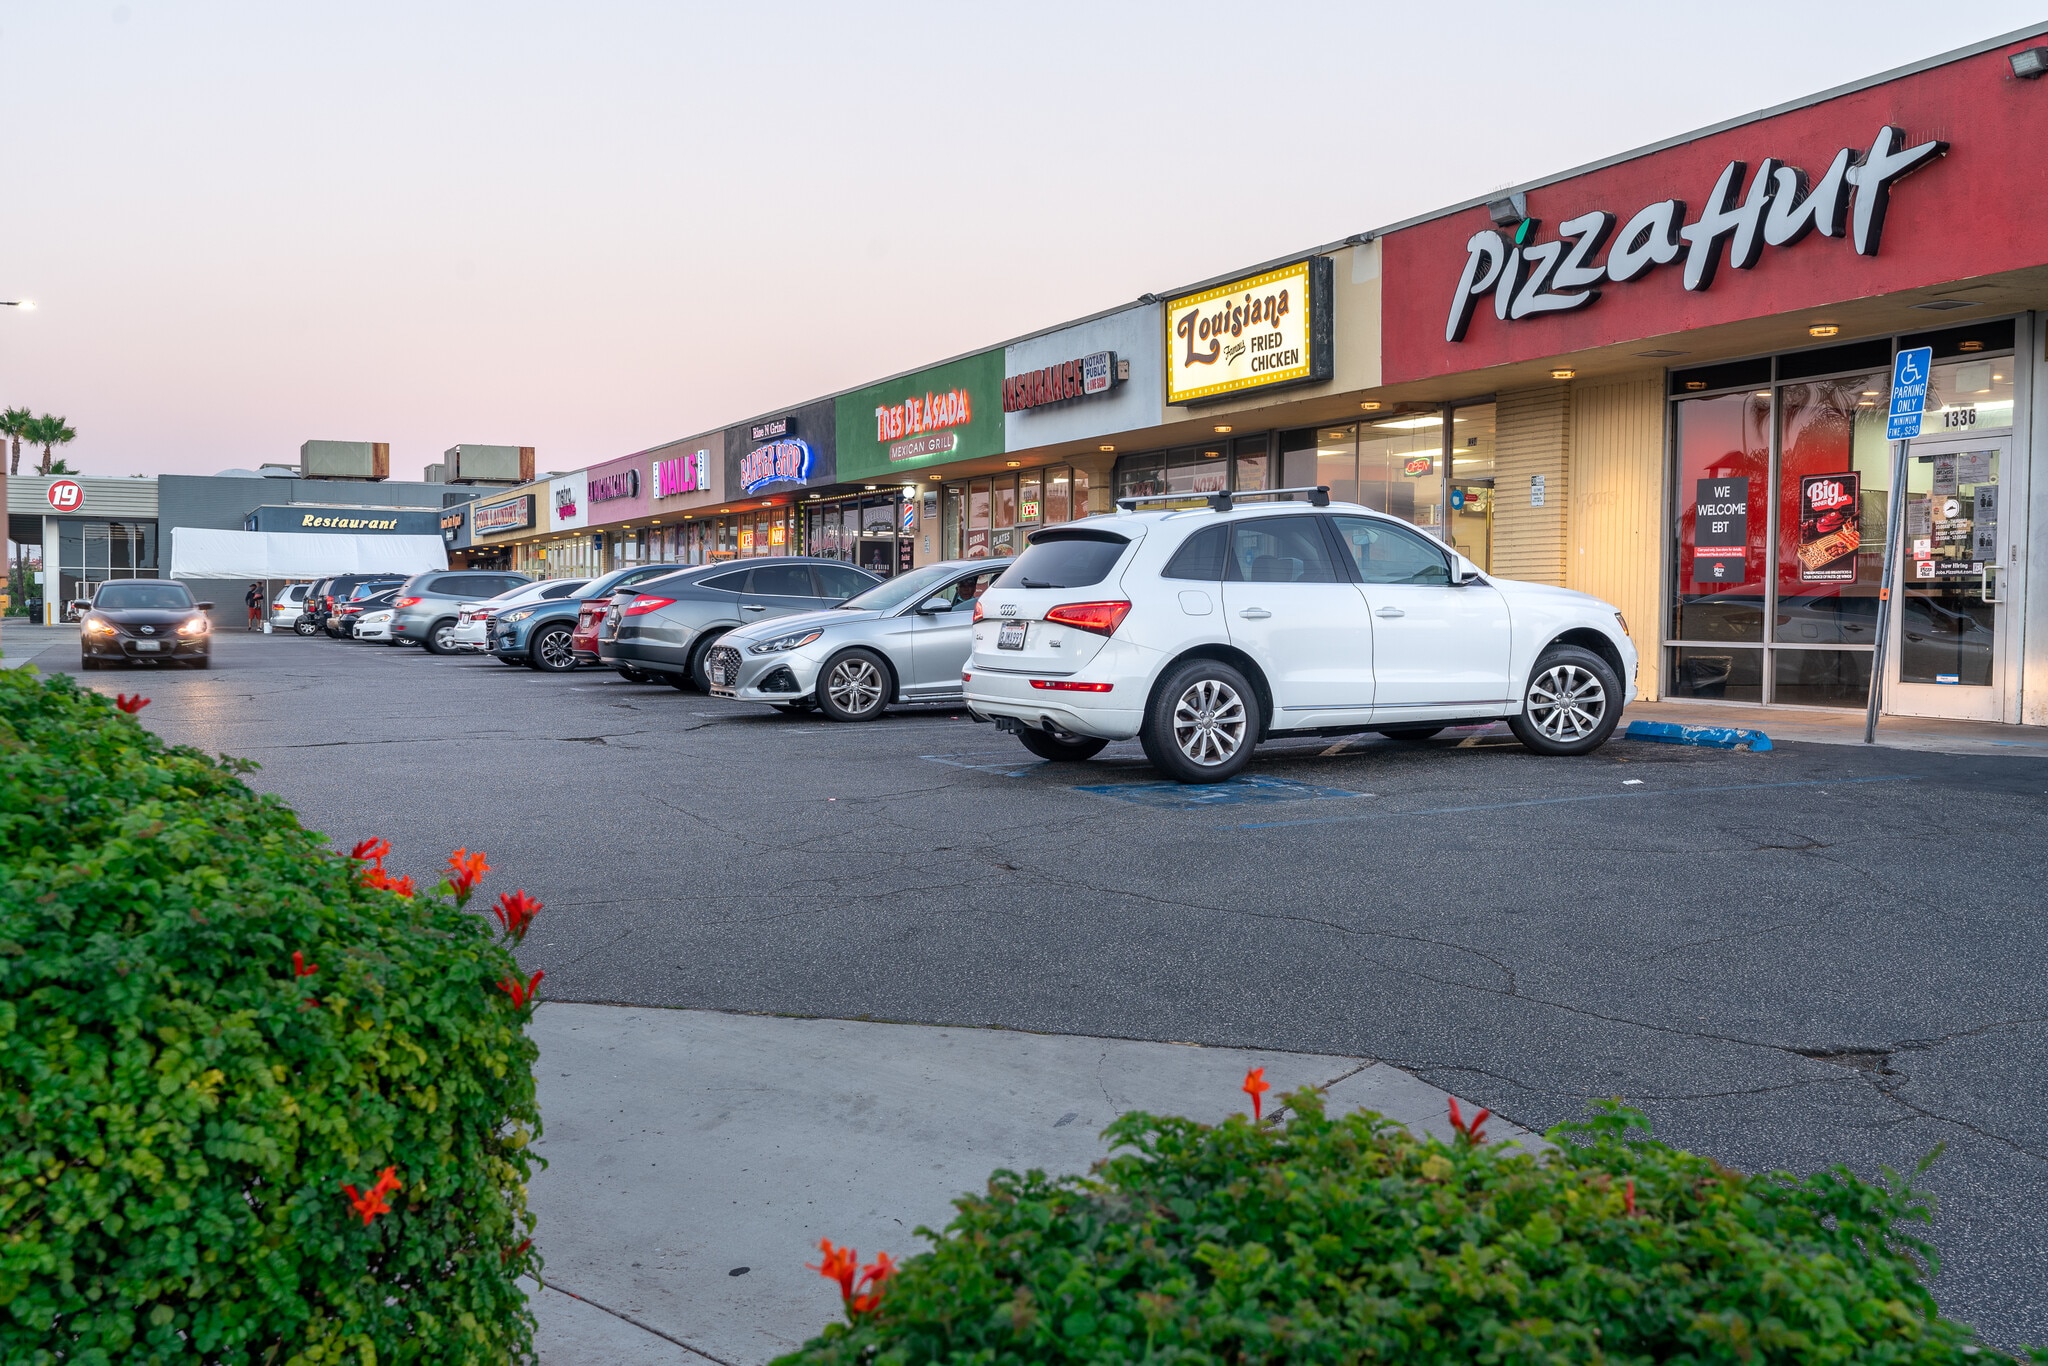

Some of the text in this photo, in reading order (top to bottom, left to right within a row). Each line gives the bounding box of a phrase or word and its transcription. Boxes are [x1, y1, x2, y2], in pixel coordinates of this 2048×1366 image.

[1681, 125, 1950, 291] Hut
[1177, 289, 1289, 368] Louisiana
[1251, 332, 1283, 353] FRIED
[1085, 353, 1107, 368] NOTARY
[1251, 348, 1299, 372] CHICKEN
[1086, 365, 1107, 379] PUBLIC
[1001, 359, 1083, 413] INSURANCE
[1893, 383, 1925, 399] PARKING
[1897, 398, 1917, 413] ONLY
[875, 389, 967, 442] TRES DE ASADA
[1893, 415, 1917, 426] MINIMUM
[1943, 408, 1976, 428] 1336
[752, 420, 786, 439] Rise N Grind
[1904, 425, 1919, 435] $250
[891, 436, 951, 458] MEXICAN GRILL
[659, 453, 697, 497] NAILS
[741, 443, 801, 490] BARBER SHOP
[1406, 460, 1429, 472] OPEN
[1193, 475, 1226, 493] NOTAR
[1714, 486, 1730, 498] WE
[1807, 480, 1839, 506] Big
[53, 485, 79, 506] 19
[476, 510, 489, 530] COIN
[490, 504, 517, 526] LAUNDRY
[1697, 503, 1746, 516] WELCOME
[302, 514, 397, 530] Restaurant
[1711, 521, 1729, 533] EBT
[969, 532, 985, 546] BIRRIA
[992, 532, 1010, 546] PLATES
